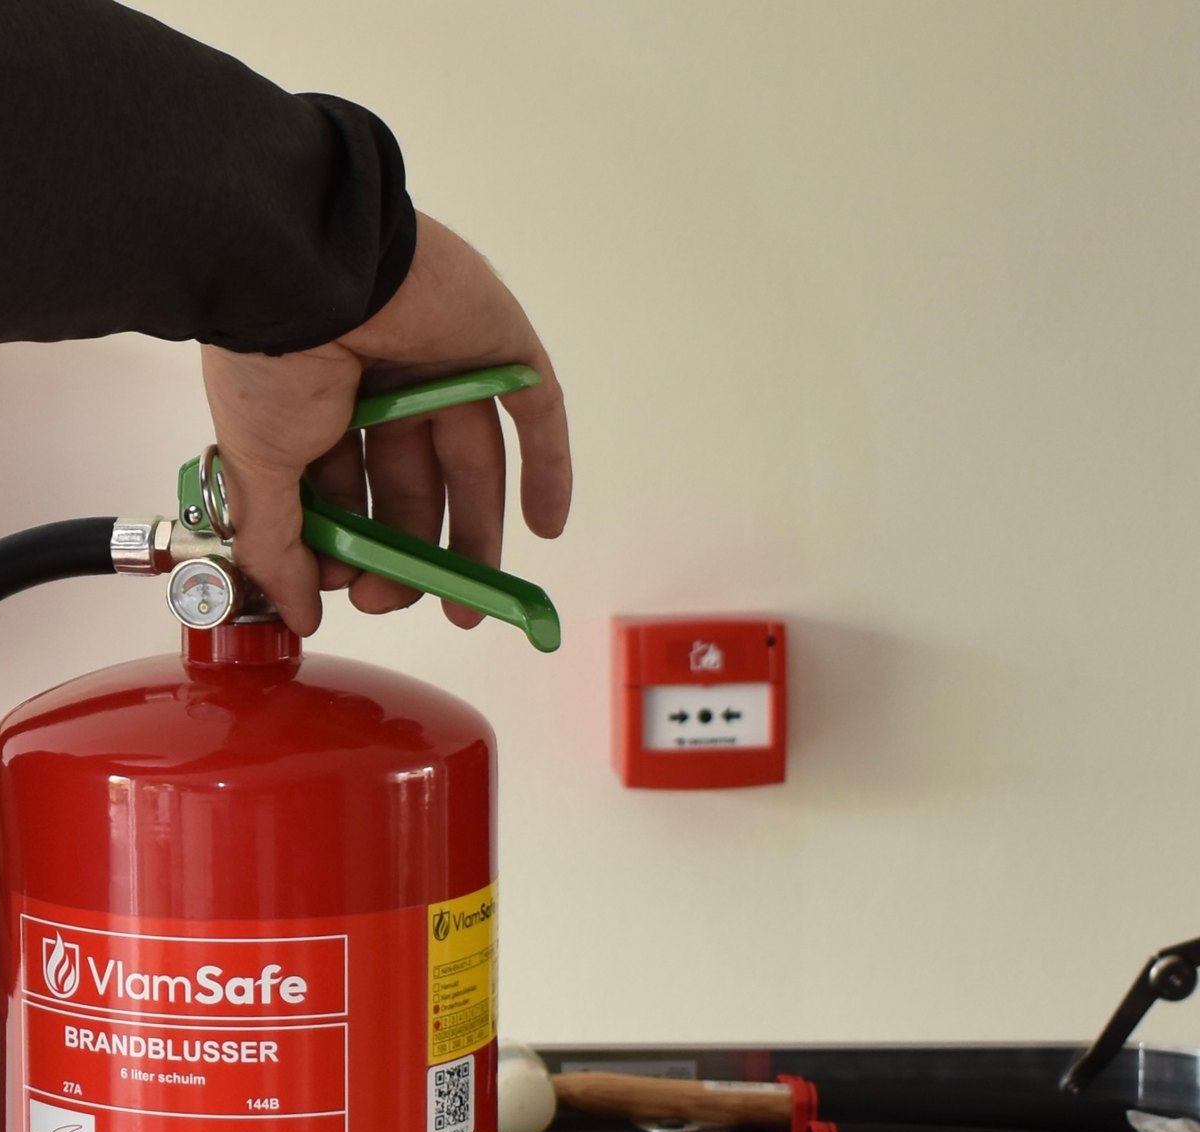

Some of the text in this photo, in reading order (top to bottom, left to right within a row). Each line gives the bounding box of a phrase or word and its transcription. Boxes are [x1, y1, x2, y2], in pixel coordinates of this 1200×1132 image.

[87, 955, 308, 1005] VlamSafe
[64, 1025, 279, 1063] BRANDBLUSSER
[120, 1067, 206, 1086] 6 liter schuim
[62, 1080, 83, 1096] 27A
[246, 1098, 280, 1110] 144B
